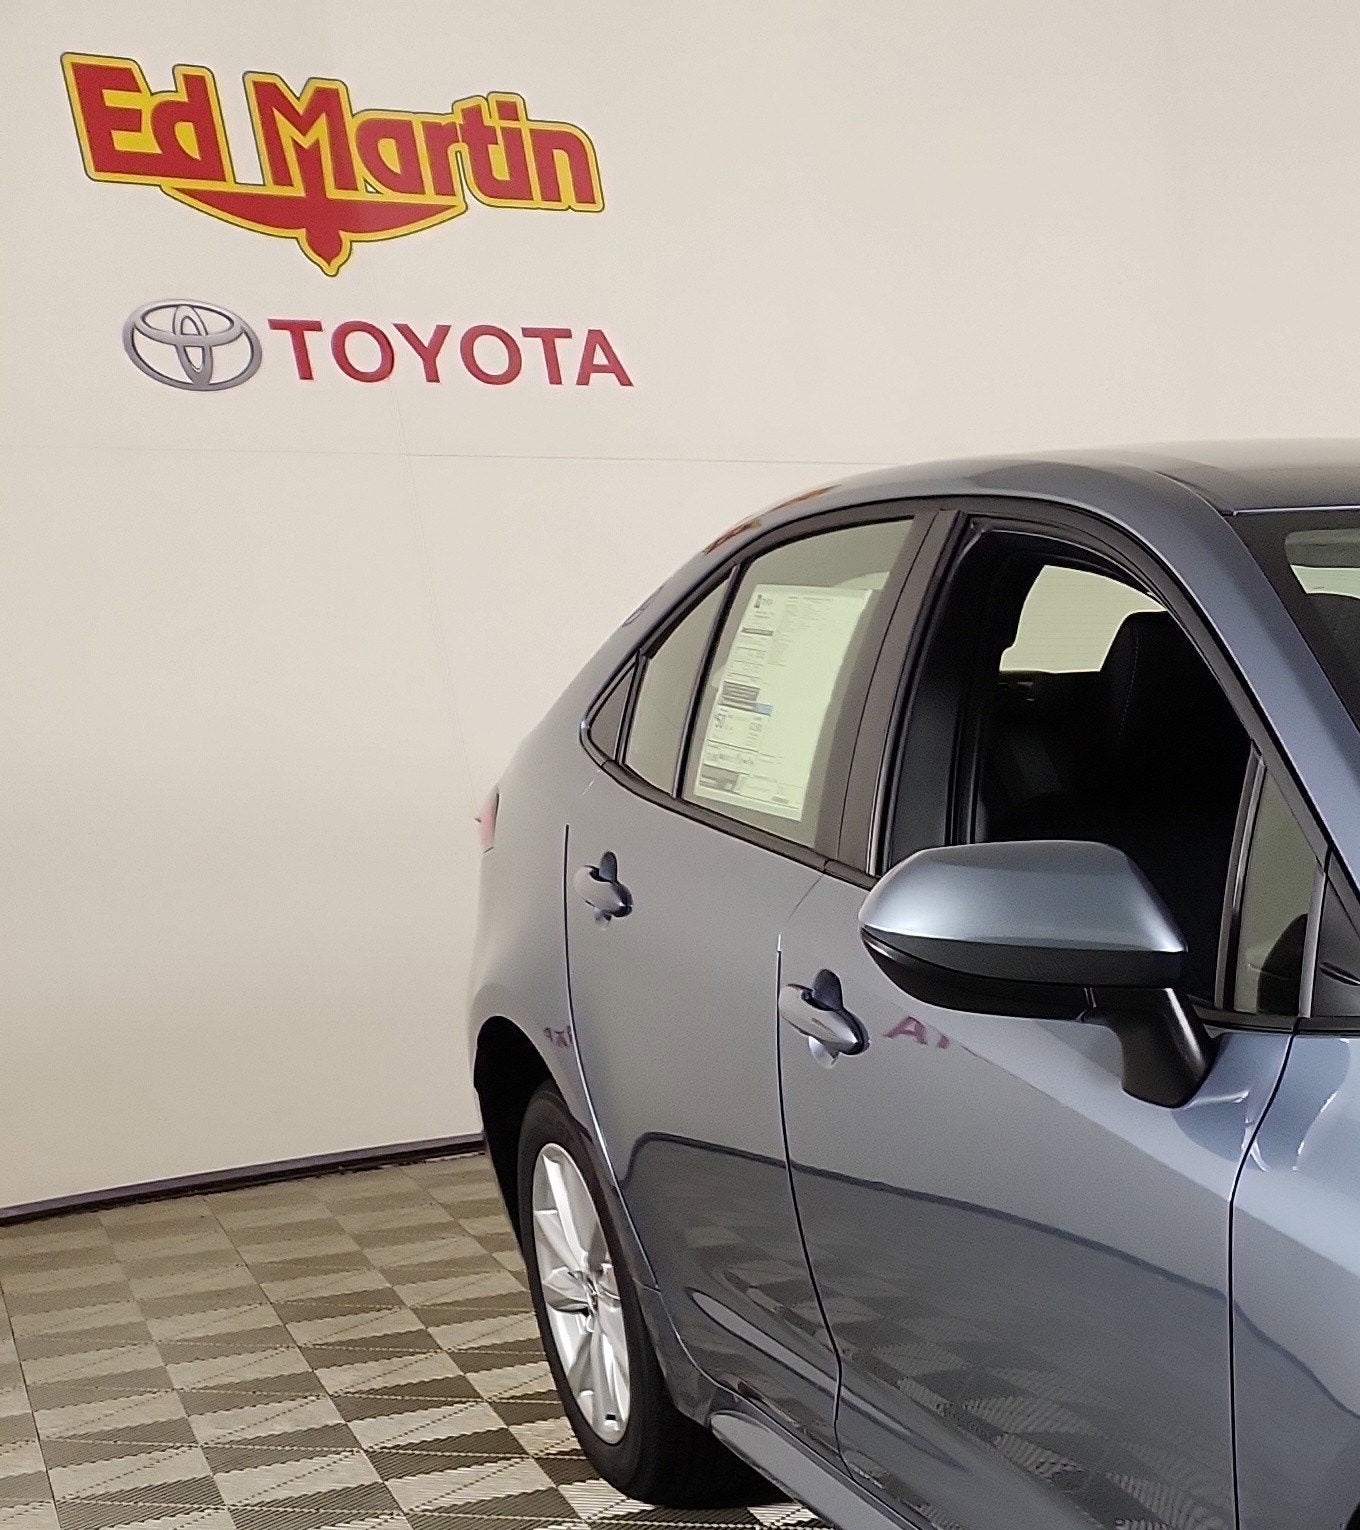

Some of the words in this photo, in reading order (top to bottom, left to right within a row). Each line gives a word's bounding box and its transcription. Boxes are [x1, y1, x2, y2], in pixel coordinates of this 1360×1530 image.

[66, 57, 232, 185] Ed
[245, 73, 601, 208] Martin
[268, 318, 635, 387] TOYOTA
